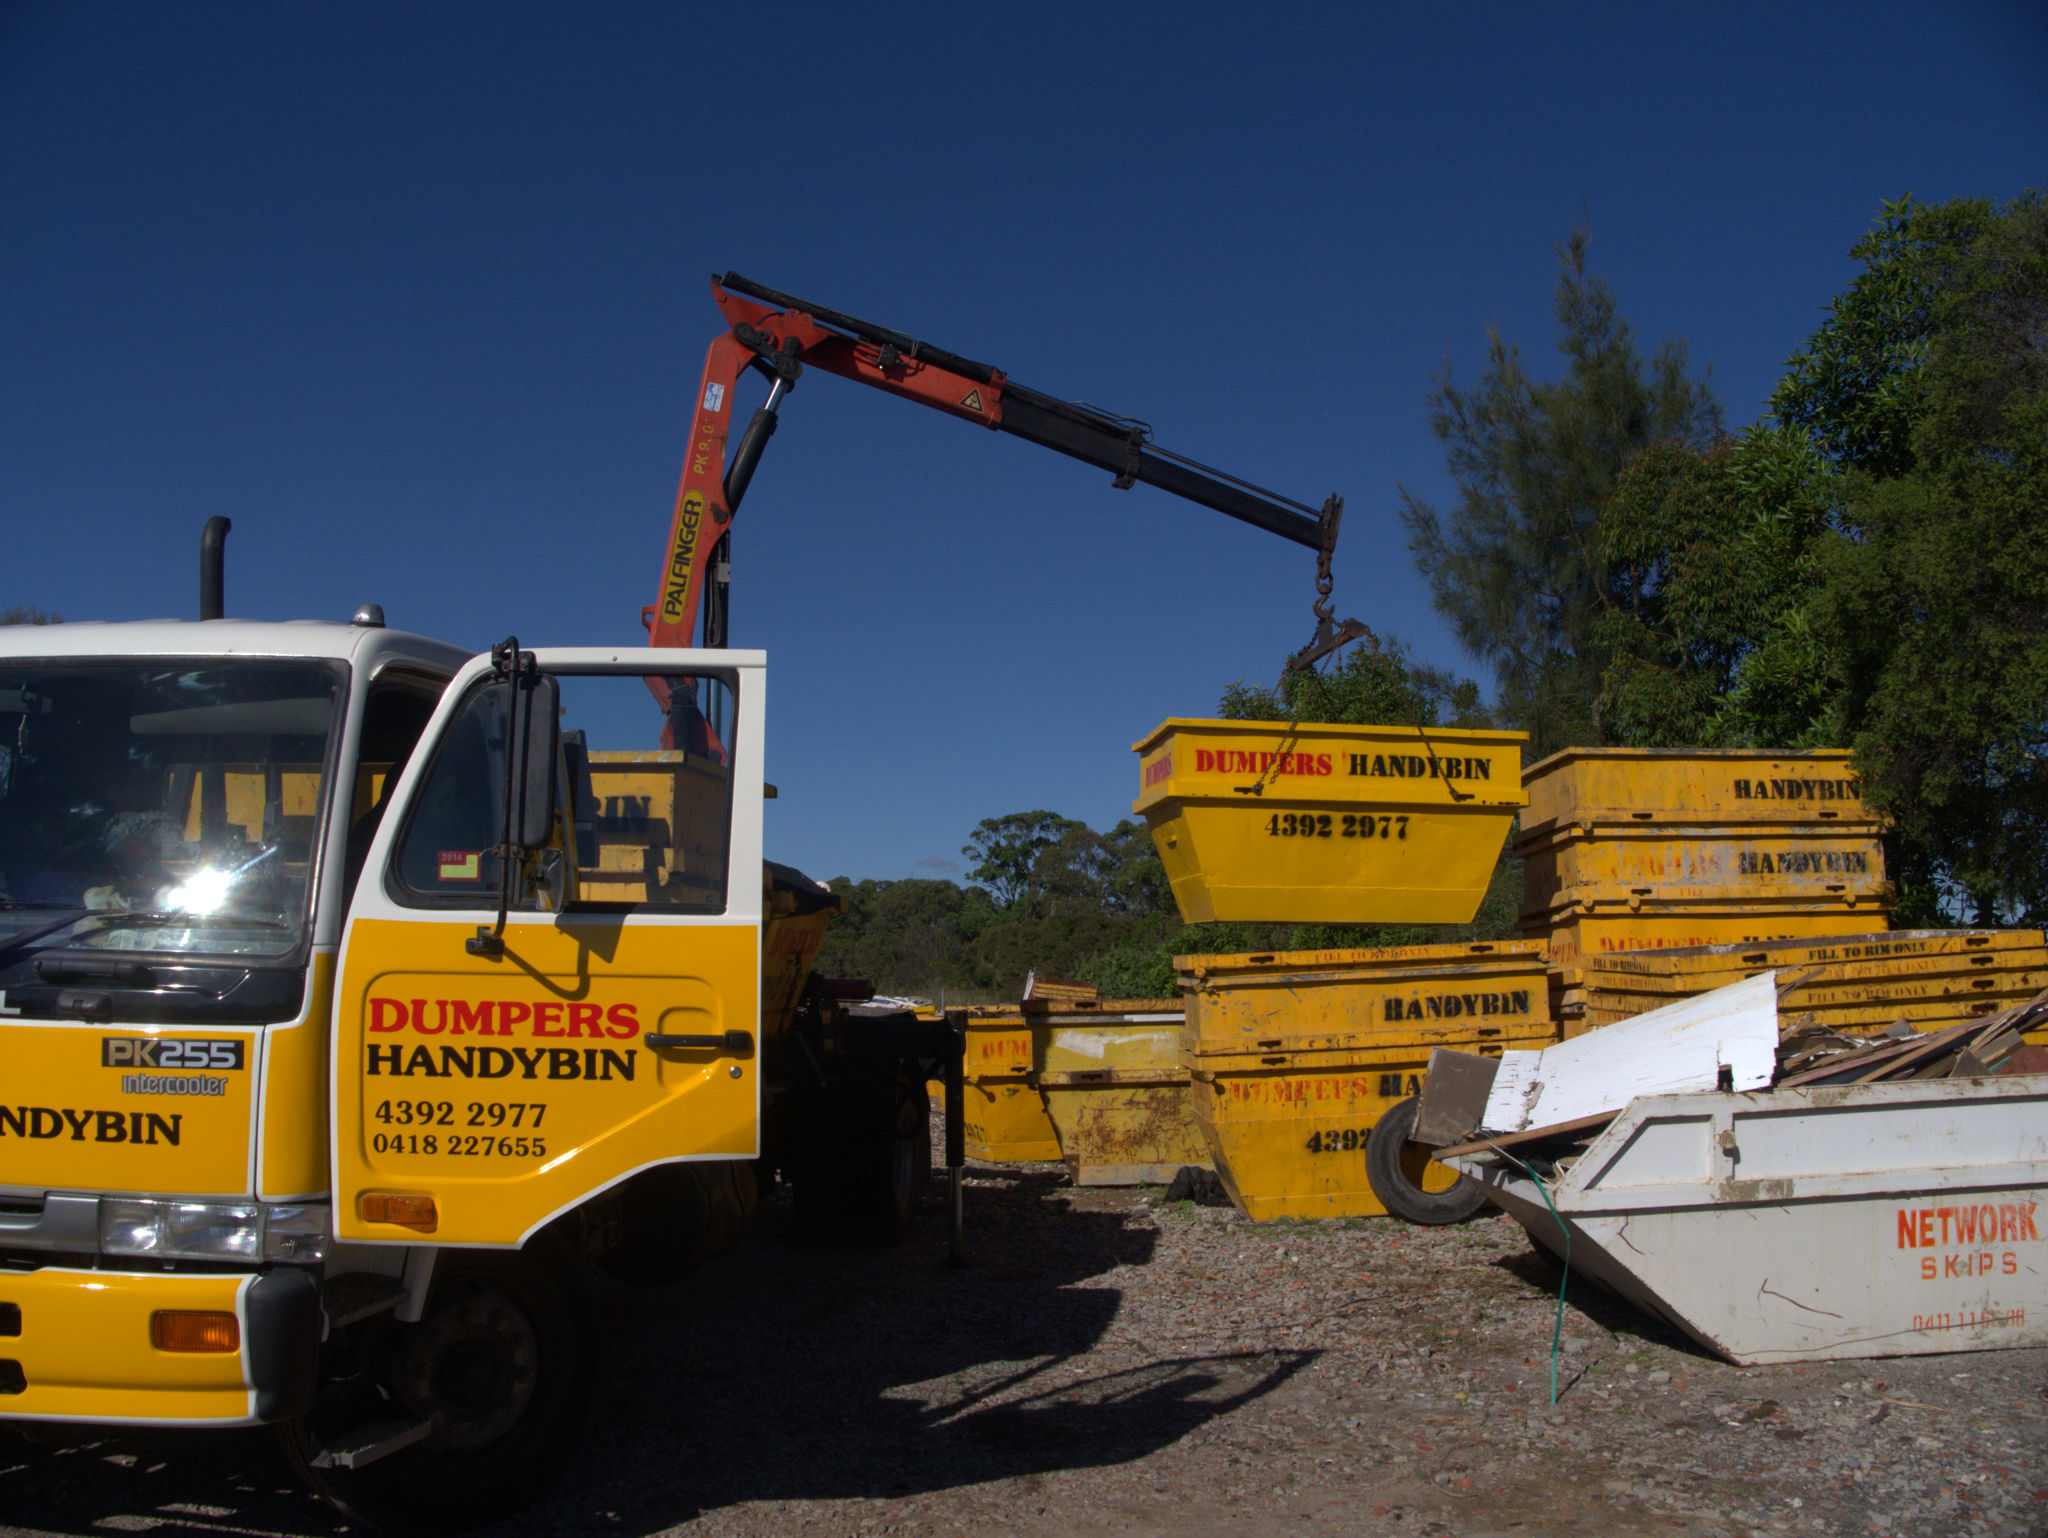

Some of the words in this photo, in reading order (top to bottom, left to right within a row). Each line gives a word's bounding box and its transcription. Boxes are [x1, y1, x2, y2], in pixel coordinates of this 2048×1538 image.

[664, 499, 702, 616] PALFINGER
[1195, 749, 1332, 777] DUMPERS
[1348, 753, 1492, 780] HANDYBIN
[1734, 778, 1861, 800] HANDYBIN
[1264, 813, 1332, 837] 4392
[1341, 814, 1410, 839] 2977
[441, 852, 463, 862] 2014
[1739, 850, 1868, 874] HANDYBIN
[1808, 948, 1839, 960] FILL
[1843, 947, 1862, 958] TO
[1865, 944, 1890, 956] RIM
[1894, 942, 1926, 953] ONLY
[369, 998, 640, 1039] DUMPERS
[1384, 990, 1529, 1021] HANDYBIN
[108, 1040, 236, 1068] PK255
[366, 1043, 637, 1081] HANDYBIN
[121, 1073, 228, 1096] intercooler
[1379, 1073, 1427, 1097] HA
[375, 1100, 455, 1126] 4392
[467, 1102, 547, 1128] 2977
[372, 1133, 438, 1155] 0418
[447, 1135, 547, 1157] 227655
[1306, 1128, 1373, 1153] 4392
[1897, 1202, 2040, 1249] NETWORK
